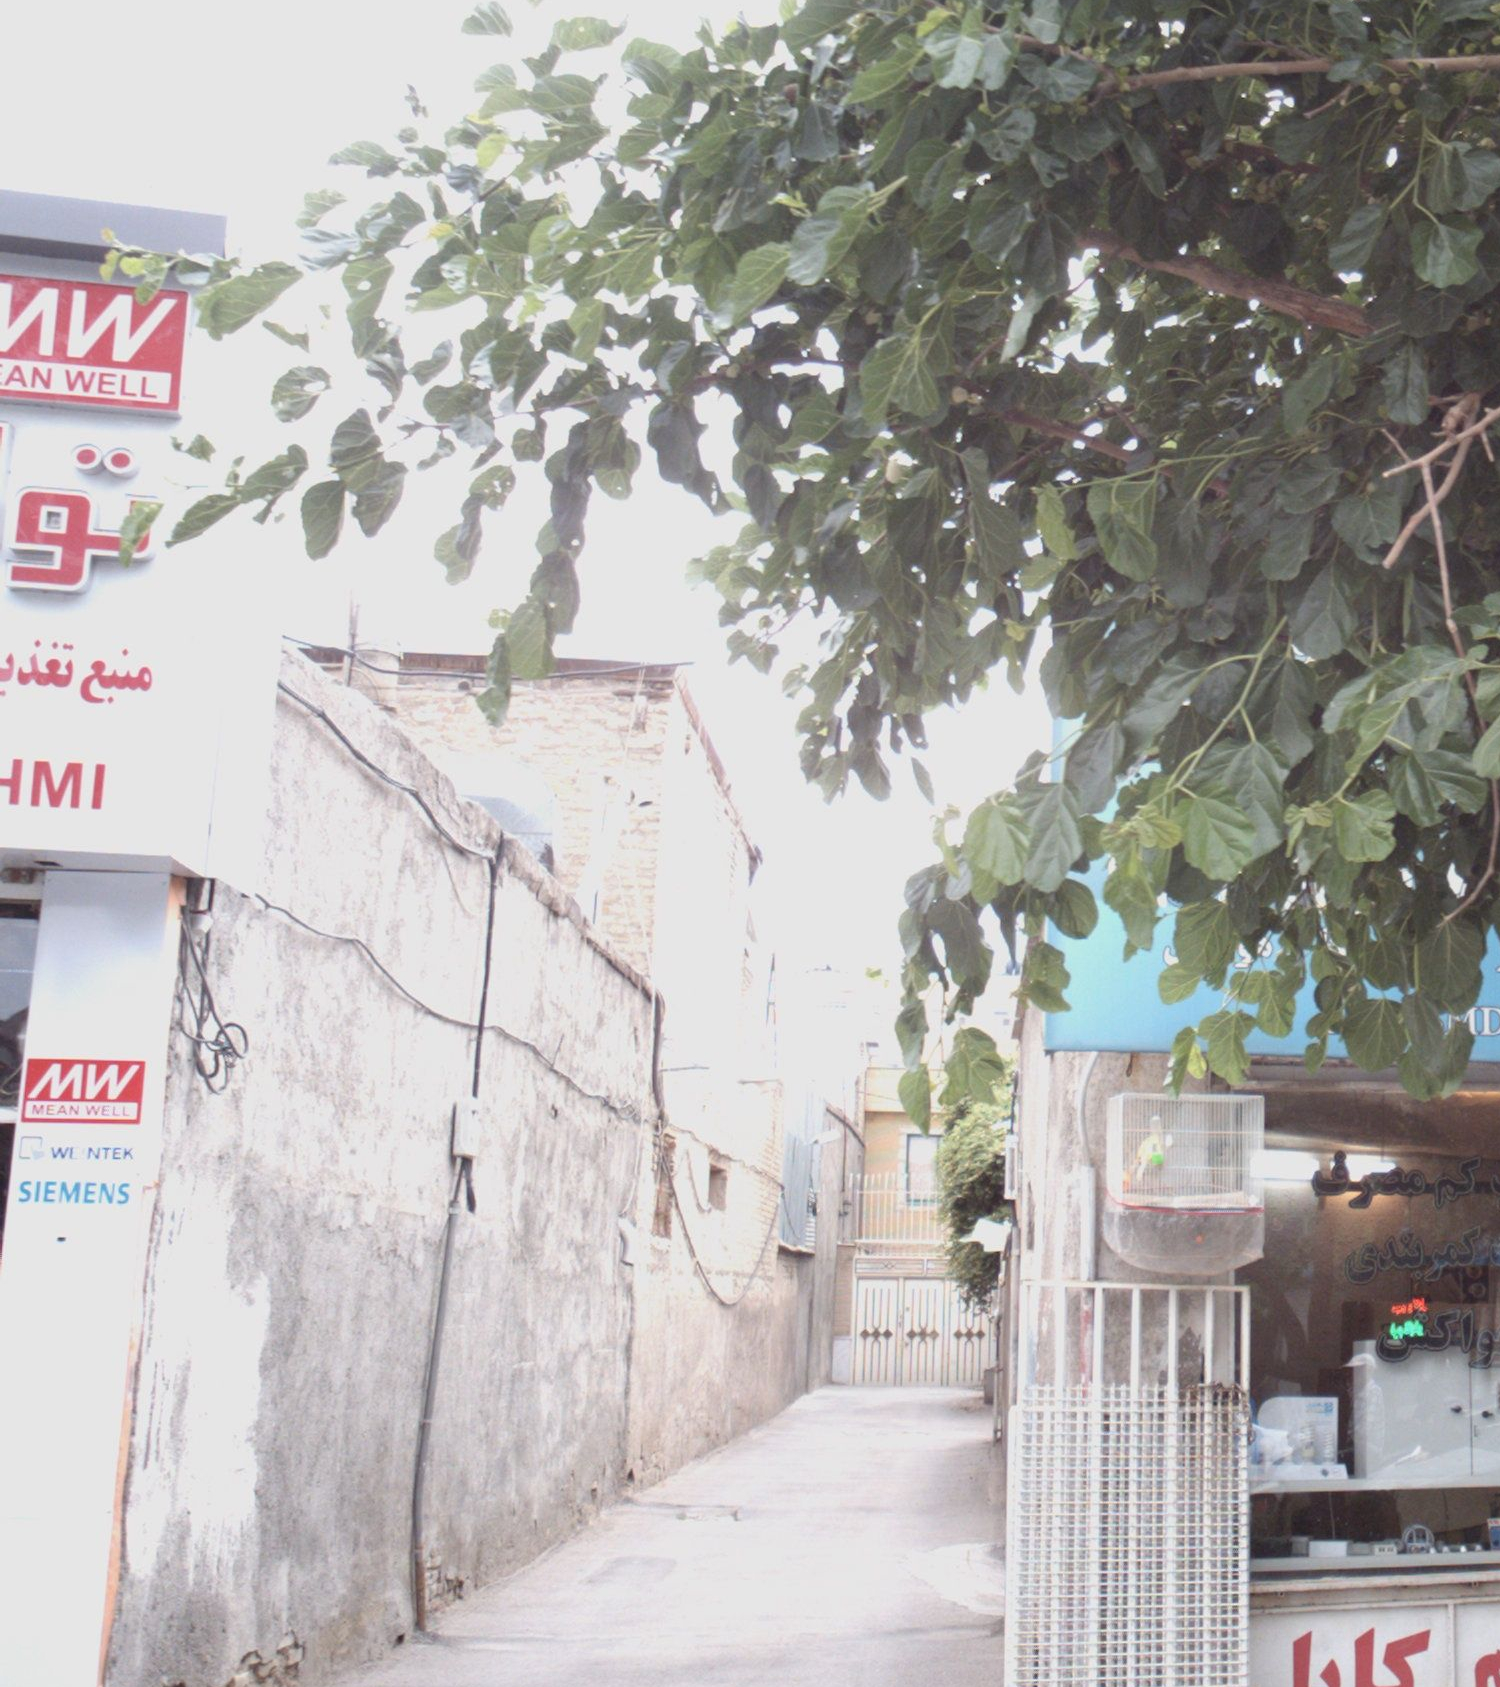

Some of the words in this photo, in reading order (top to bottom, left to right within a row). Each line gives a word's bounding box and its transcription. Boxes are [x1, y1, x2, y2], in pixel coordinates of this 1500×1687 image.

[0, 364, 53, 390] AN
[65, 369, 158, 399] WELL
[0, 639, 75, 697] تغذی
[80, 648, 153, 704] منبع
[27, 1062, 141, 1100] MW
[31, 1104, 80, 1117] MEAN
[86, 1105, 131, 1118] WELL
[18, 1180, 131, 1205] SIEMENS
[1311, 1149, 1426, 1209] مصرف
[1433, 1155, 1482, 1209] کم
